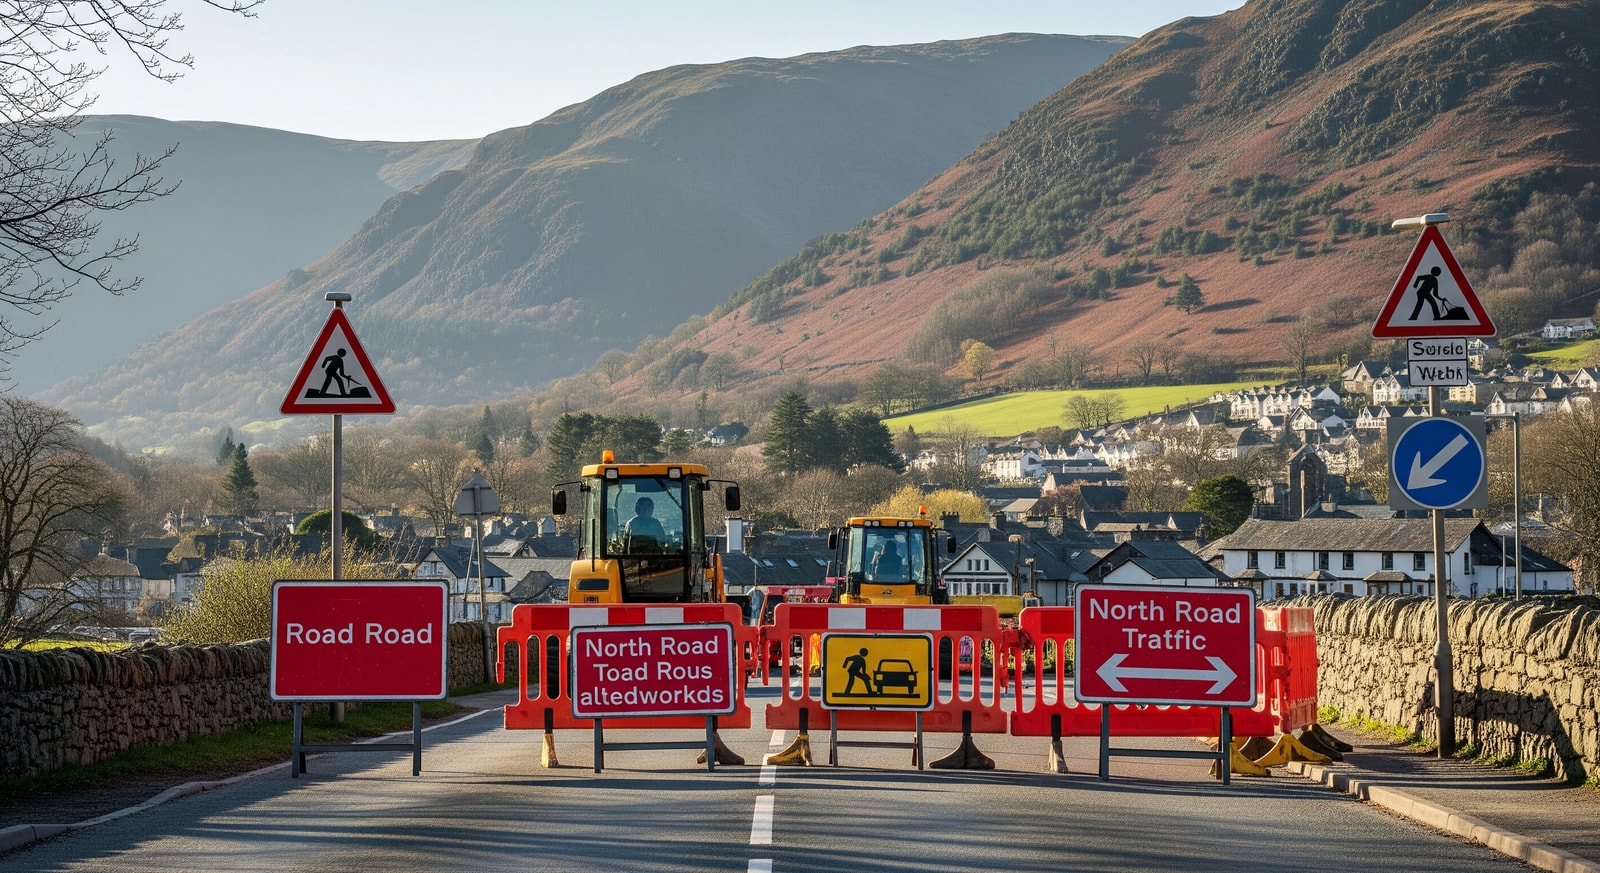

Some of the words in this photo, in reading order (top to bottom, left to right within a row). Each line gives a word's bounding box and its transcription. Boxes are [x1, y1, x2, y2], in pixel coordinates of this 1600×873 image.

[1089, 598, 1165, 622] North
[1175, 600, 1241, 624] Road
[286, 622, 354, 645] Road
[365, 622, 432, 645] Road
[585, 636, 651, 658] North
[660, 635, 719, 656] Road
[592, 661, 648, 682] Toad
[657, 661, 713, 681] Rous
[580, 685, 724, 706] altedworkds
